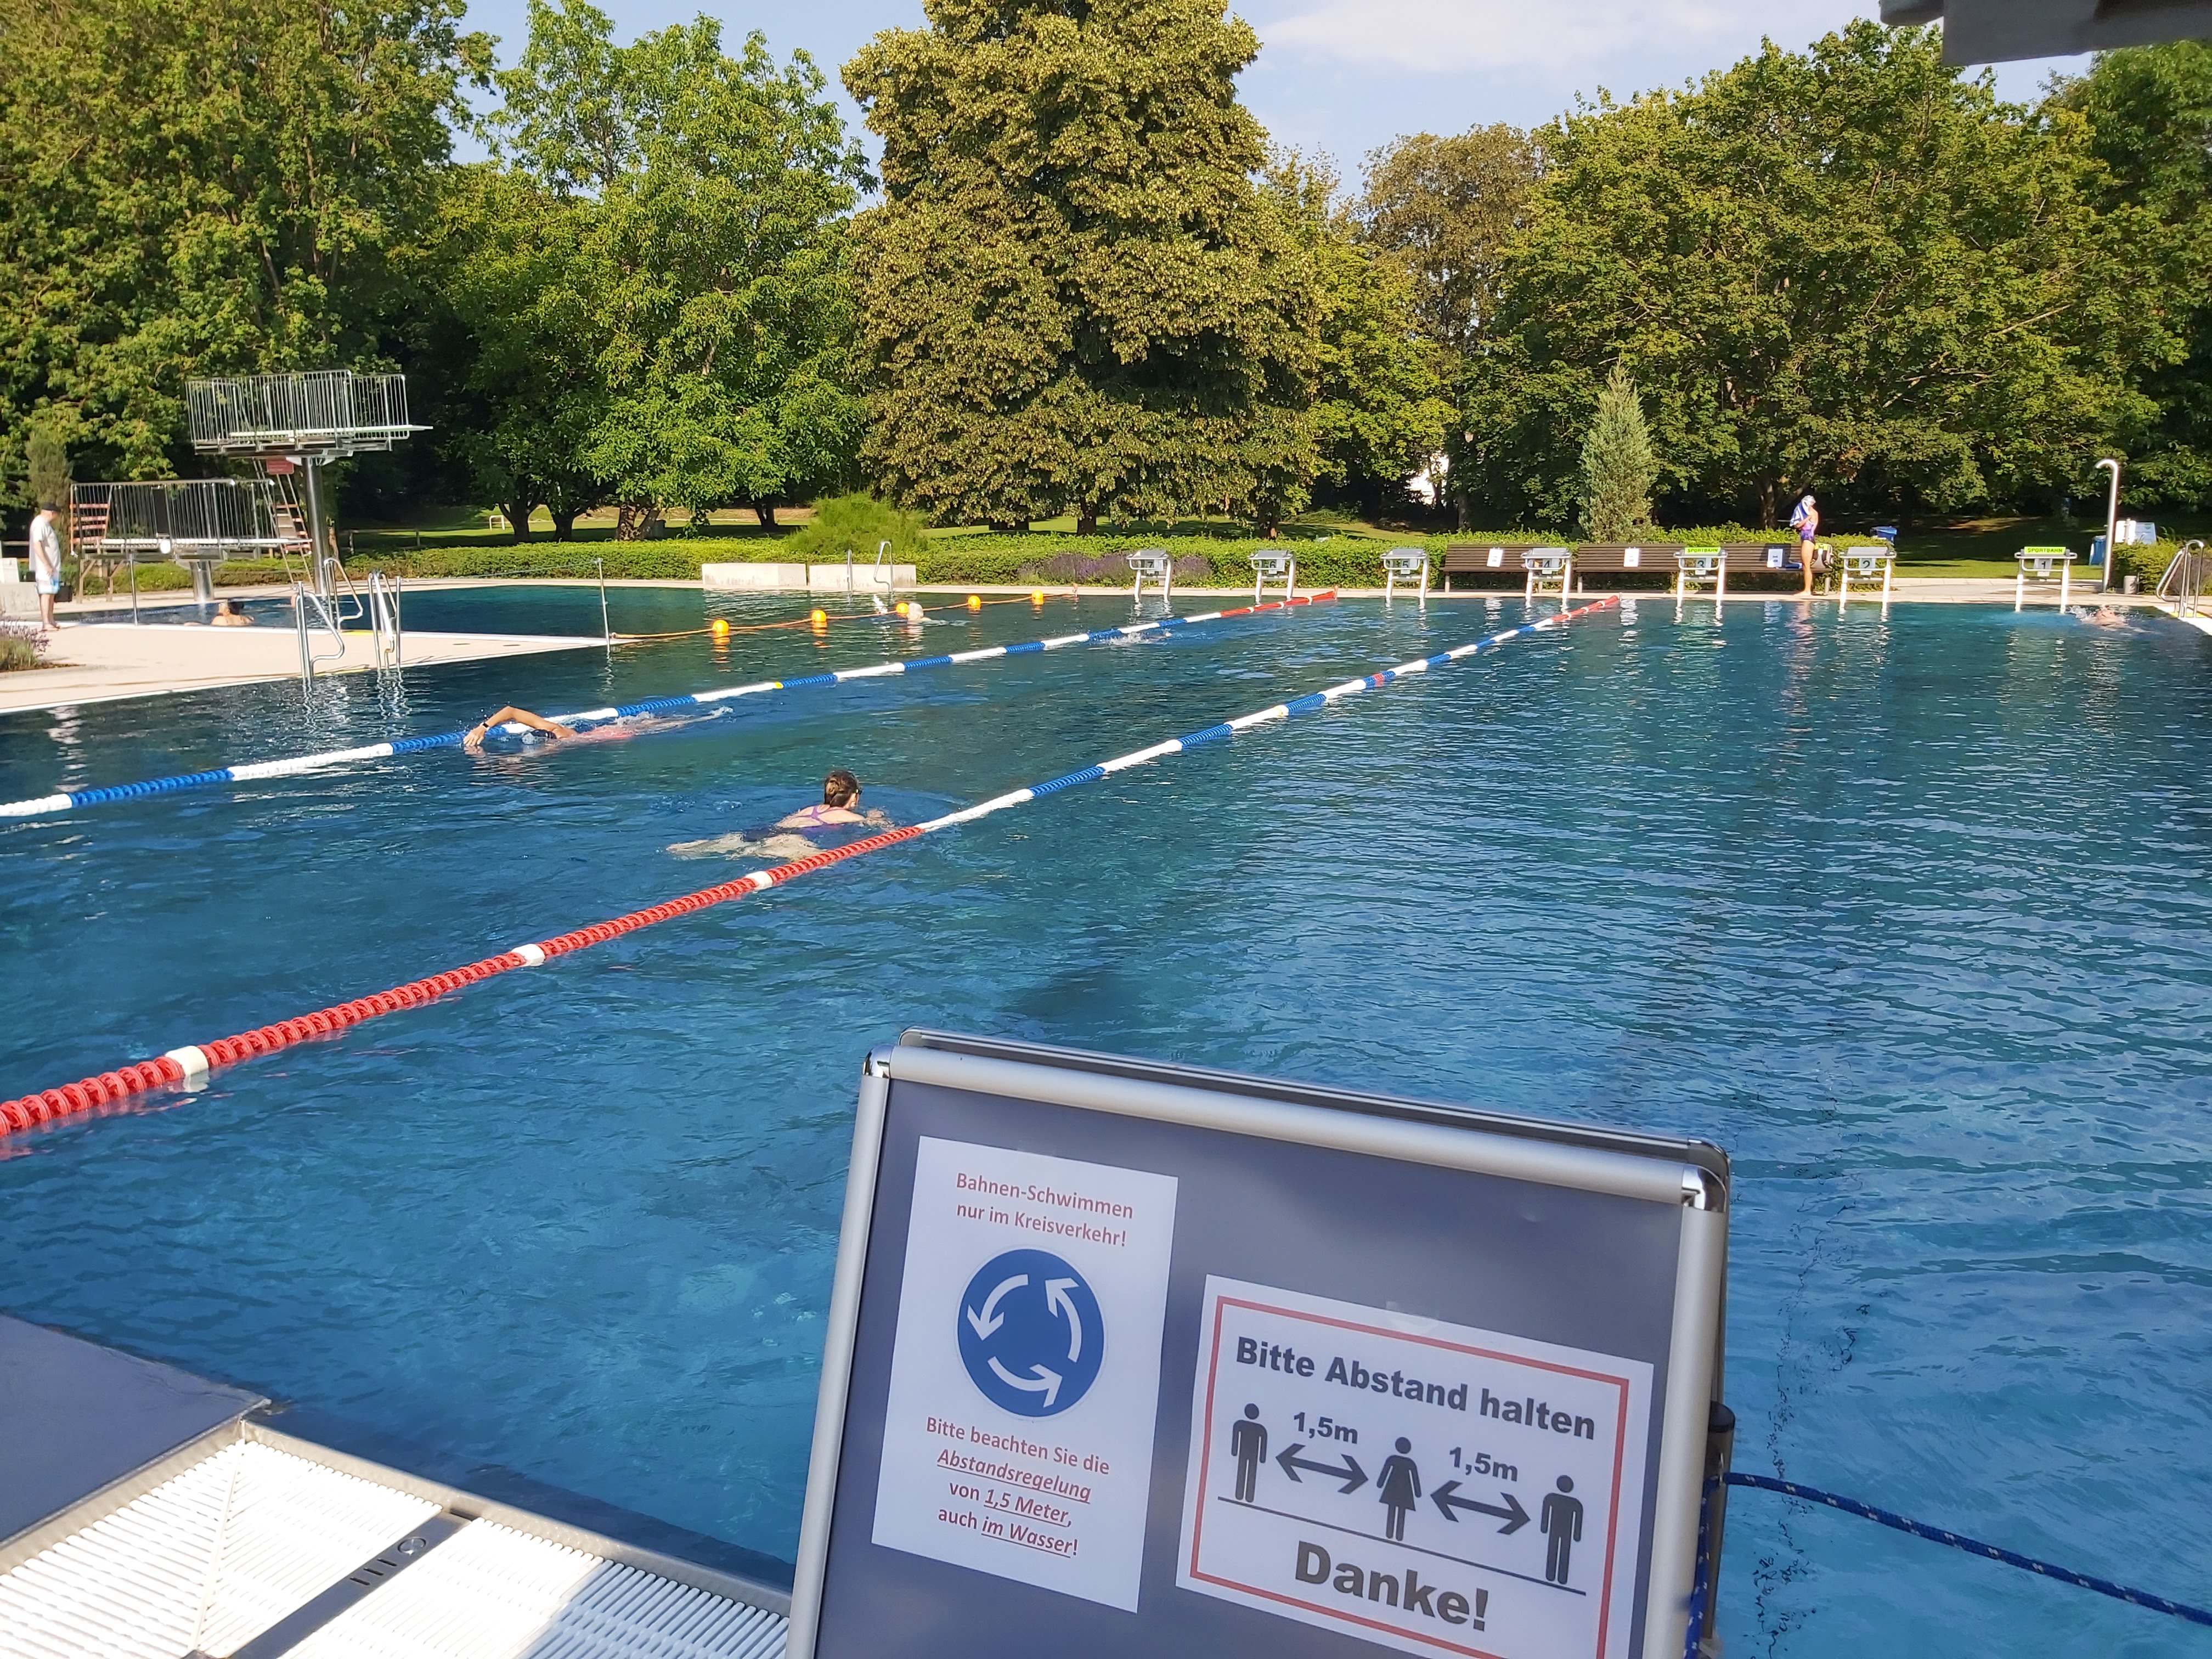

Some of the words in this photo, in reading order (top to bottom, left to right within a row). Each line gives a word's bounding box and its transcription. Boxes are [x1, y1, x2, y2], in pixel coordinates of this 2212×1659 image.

[2041, 561, 2046, 569] 1
[956, 1173, 1133, 1219] Bahnen-Schwimmen
[957, 1204, 985, 1220] nur
[990, 1206, 1009, 1224] im
[1015, 1211, 1126, 1246] Kreisverkehr!
[1237, 1336, 1315, 1377] Bitte
[1324, 1357, 1468, 1412] Abstand
[1480, 1388, 1595, 1441] halten
[926, 1417, 965, 1440] Bitte
[970, 1426, 1048, 1459] beachten
[1053, 1447, 1078, 1466] Sie
[1084, 1454, 1110, 1475] die
[1294, 1412, 1358, 1444] 1,5m
[937, 1449, 1092, 1502] Abstandsregelung
[1449, 1447, 1518, 1482] 1,5m
[950, 1482, 980, 1501] von
[984, 1489, 1012, 1509] 1,5
[1014, 1496, 1071, 1527] Meter,
[939, 1508, 977, 1530] auch
[981, 1516, 1004, 1536] im
[1009, 1523, 1078, 1556] Wasser!
[1295, 1541, 1489, 1632] Danke!
